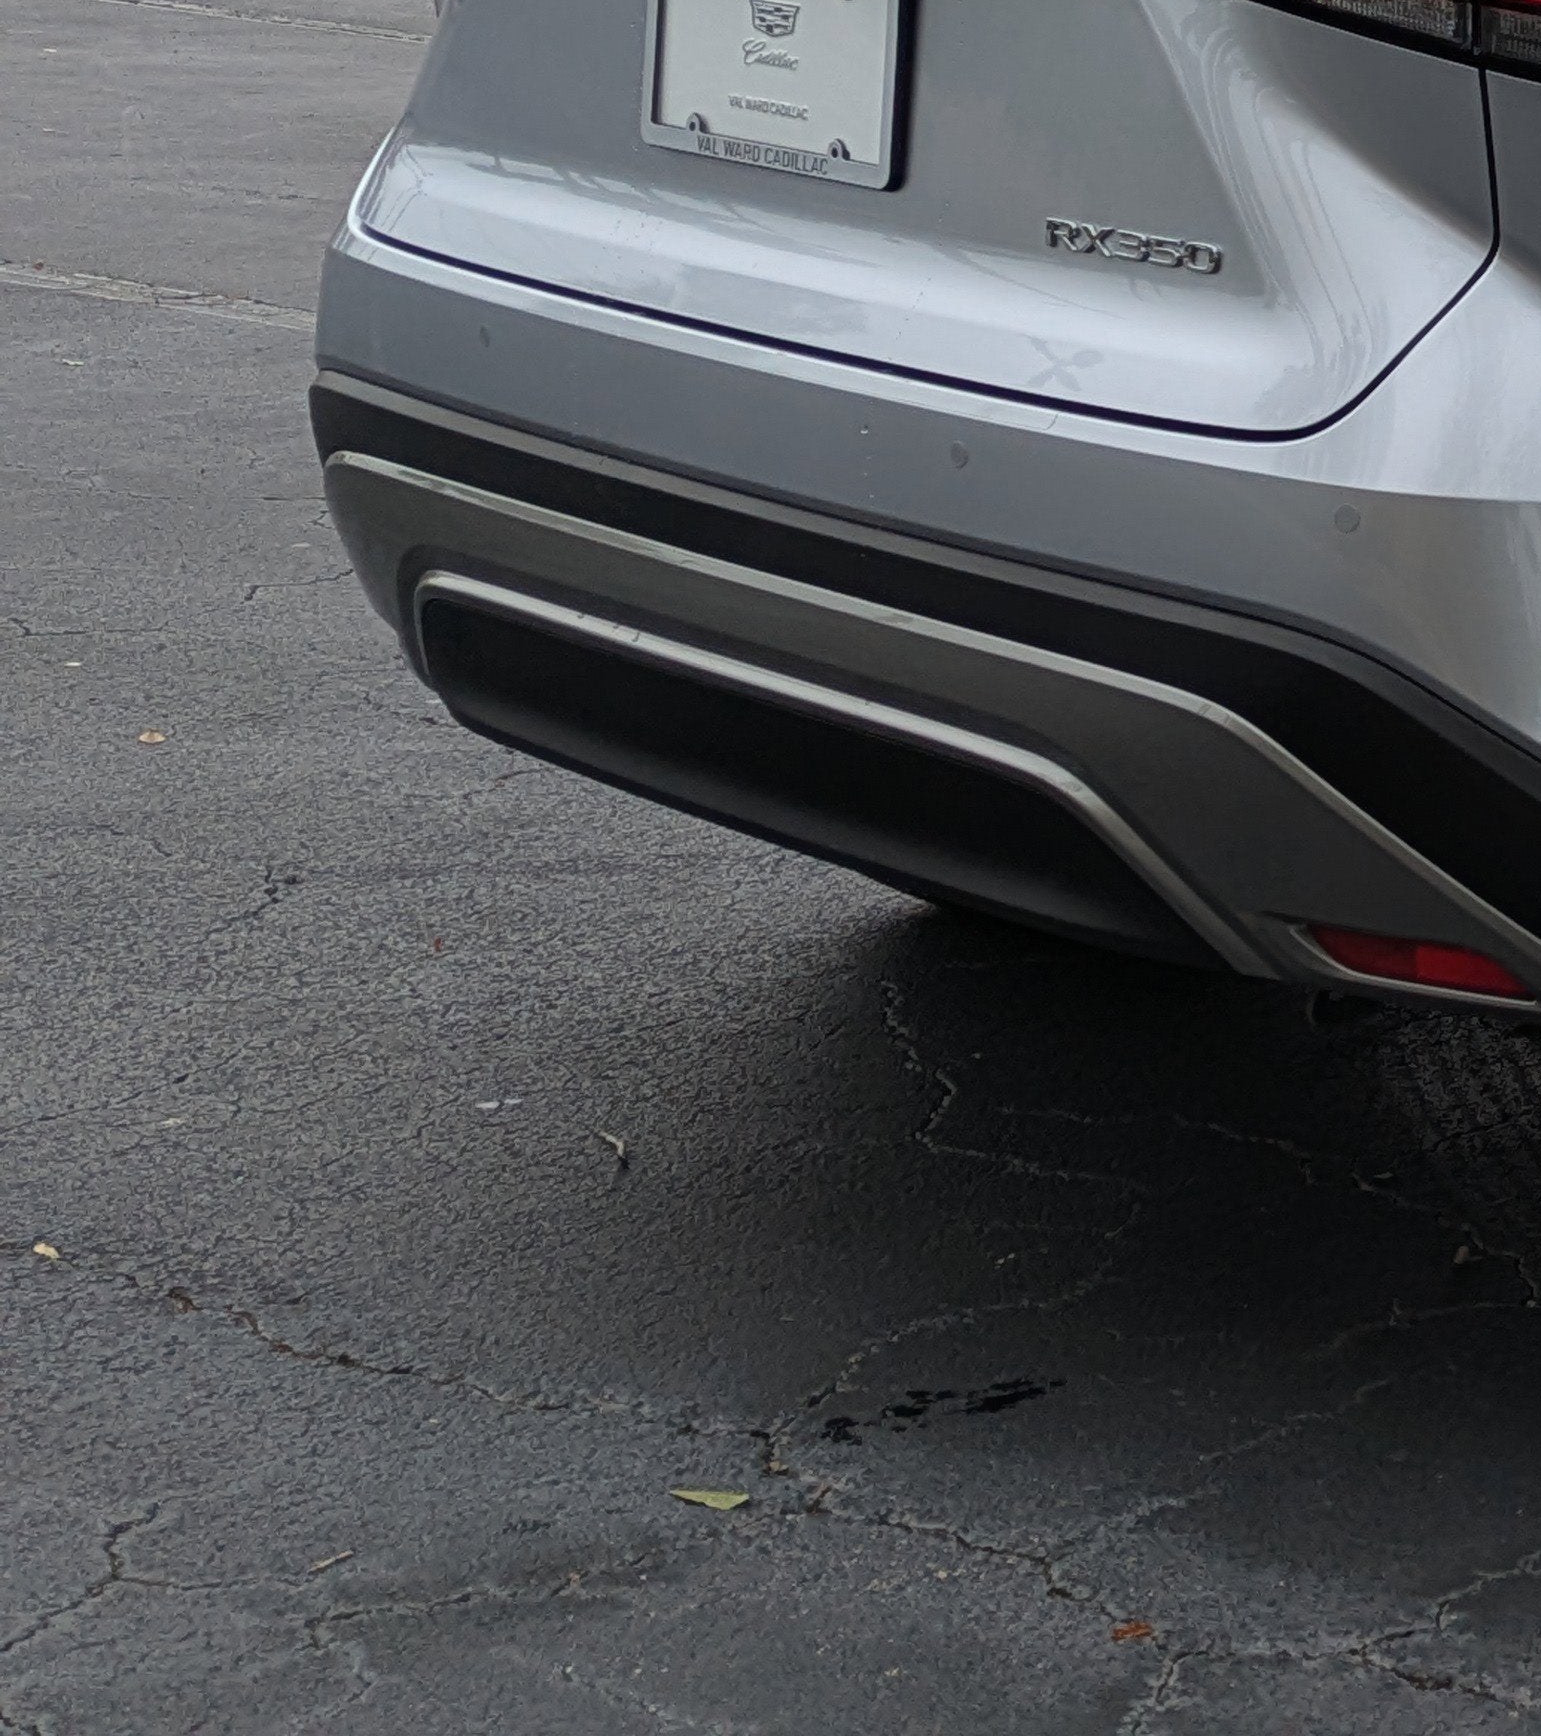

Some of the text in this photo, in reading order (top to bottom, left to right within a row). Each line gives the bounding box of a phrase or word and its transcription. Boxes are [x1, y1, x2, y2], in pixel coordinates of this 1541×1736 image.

[743, 38, 800, 71] Cadillac
[697, 135, 829, 176] VAL WARD CADILLAC
[1045, 217, 1222, 274] RX350
